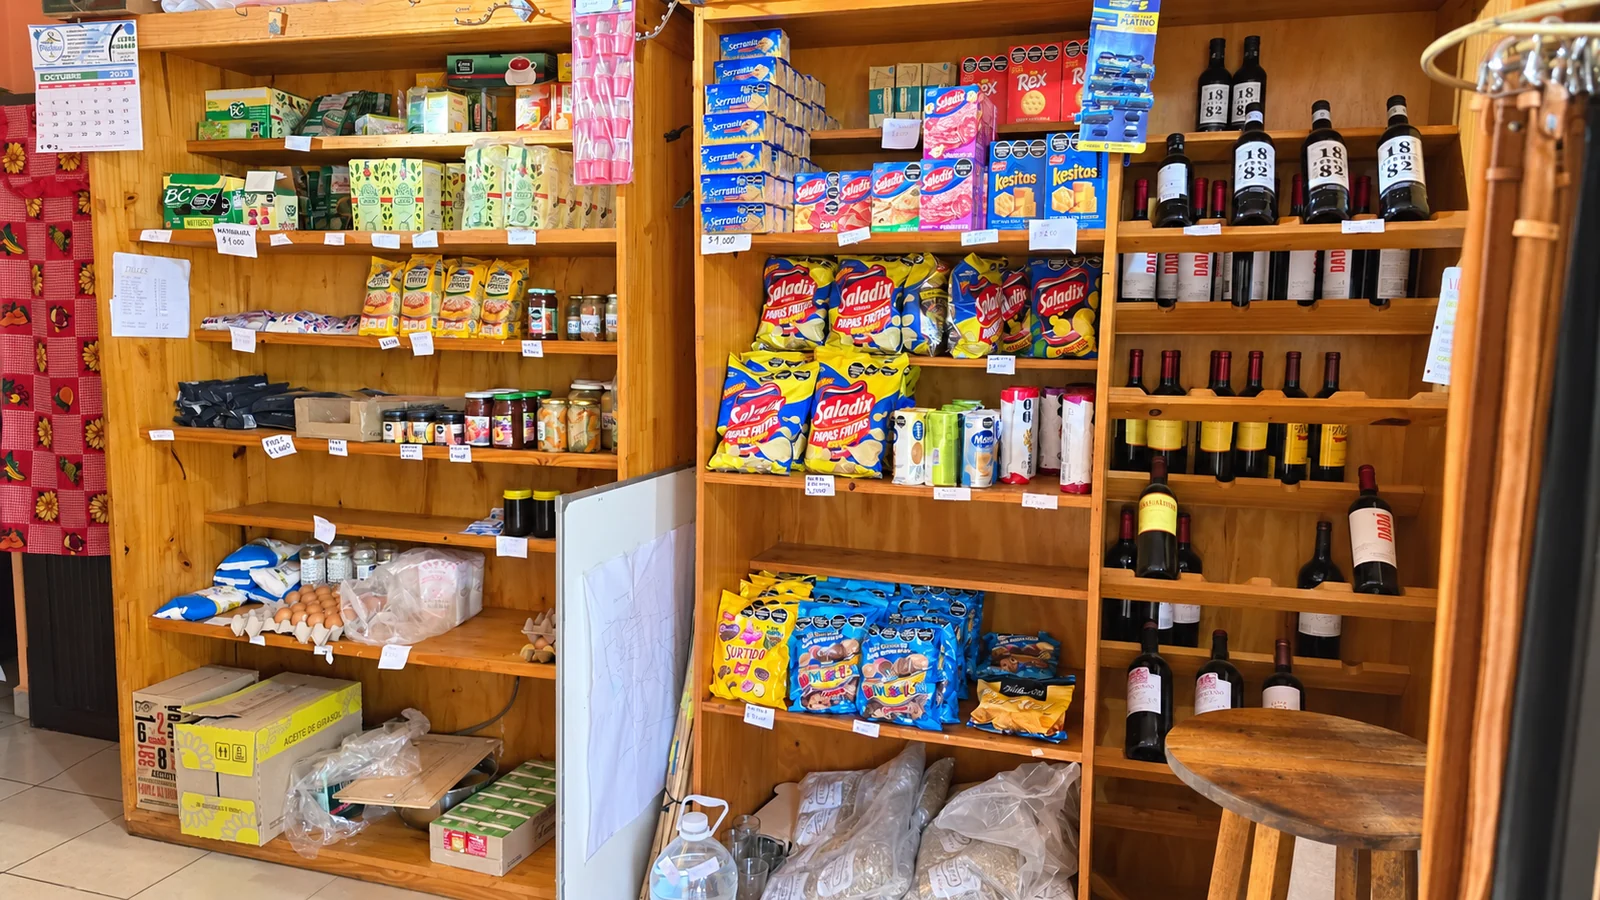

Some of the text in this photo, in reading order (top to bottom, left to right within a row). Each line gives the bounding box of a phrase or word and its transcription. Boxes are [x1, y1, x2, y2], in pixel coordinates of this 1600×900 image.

[1120, 18, 1156, 27] PLATINO
[44, 73, 82, 81] OCTUBRE
[1017, 72, 1047, 91] Rex
[981, 81, 998, 96] ex
[1208, 89, 1223, 101] 18
[1238, 87, 1254, 100] 18
[1206, 105, 1222, 118] 82
[1247, 147, 1268, 161] 18
[1319, 146, 1343, 161] 18
[1387, 141, 1411, 158] 18
[1244, 166, 1268, 180] 82
[1319, 164, 1344, 178] 82
[1387, 161, 1413, 178] 82
[165, 188, 192, 204] BC
[1194, 252, 1209, 276] DAD
[1330, 250, 1345, 273] DAD
[767, 280, 815, 307] Saladix
[840, 282, 893, 313] Saladix
[1039, 285, 1084, 314] Saladix
[814, 393, 873, 425] Saladix
[725, 644, 766, 662] SURTIDO
[283, 711, 343, 746] ACEITE DE GIRASOL
